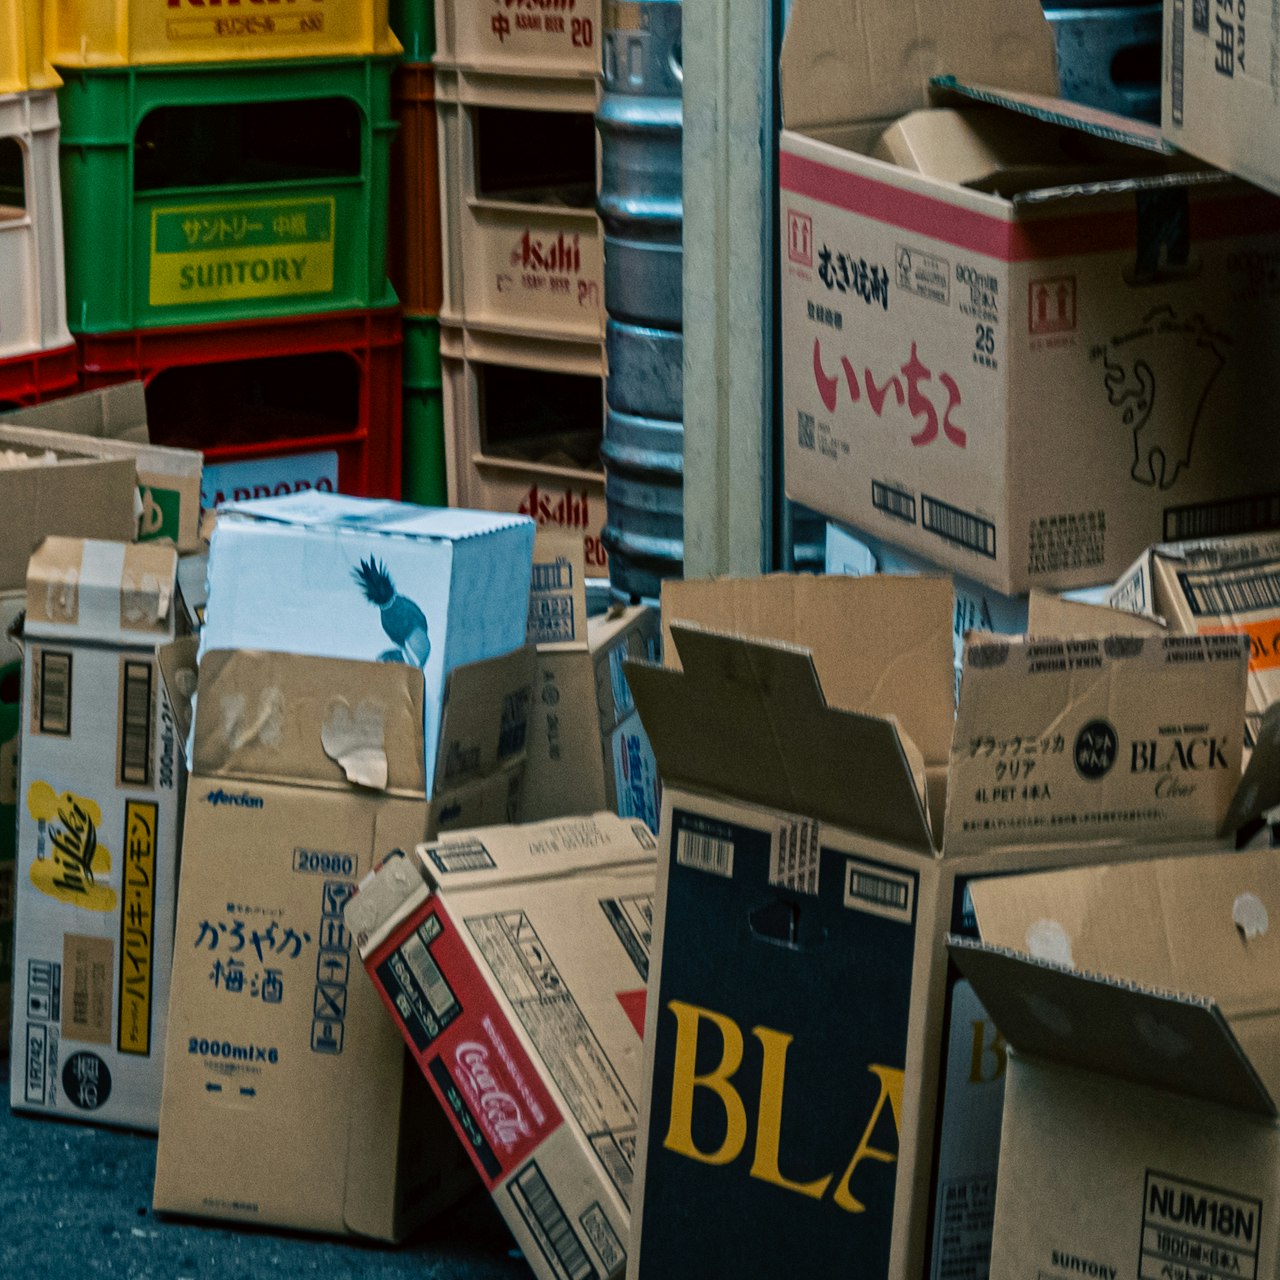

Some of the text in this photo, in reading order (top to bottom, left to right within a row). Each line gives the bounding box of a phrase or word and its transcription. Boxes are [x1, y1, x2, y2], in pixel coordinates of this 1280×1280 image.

[491, 12, 511, 44] 中
[571, 17, 593, 48] 20
[511, 227, 581, 274] Asahi
[179, 256, 307, 291] SUNTORY
[974, 323, 996, 355] 25
[813, 335, 967, 449] いいちこ
[518, 484, 589, 530] Asahi
[584, 535, 607, 566] 20
[971, 733, 1065, 758] ブラックニッカ
[1130, 735, 1231, 774] BLACK
[207, 788, 264, 809] Mercian
[993, 785, 1015, 802] PET
[298, 851, 353, 875] 20980
[194, 918, 312, 963] かろやか
[208, 956, 284, 1004] 梅酒
[71, 1055, 101, 1109] お酒
[455, 1040, 532, 1152] Coca-Cola
[1150, 1183, 1254, 1242] NUM18N
